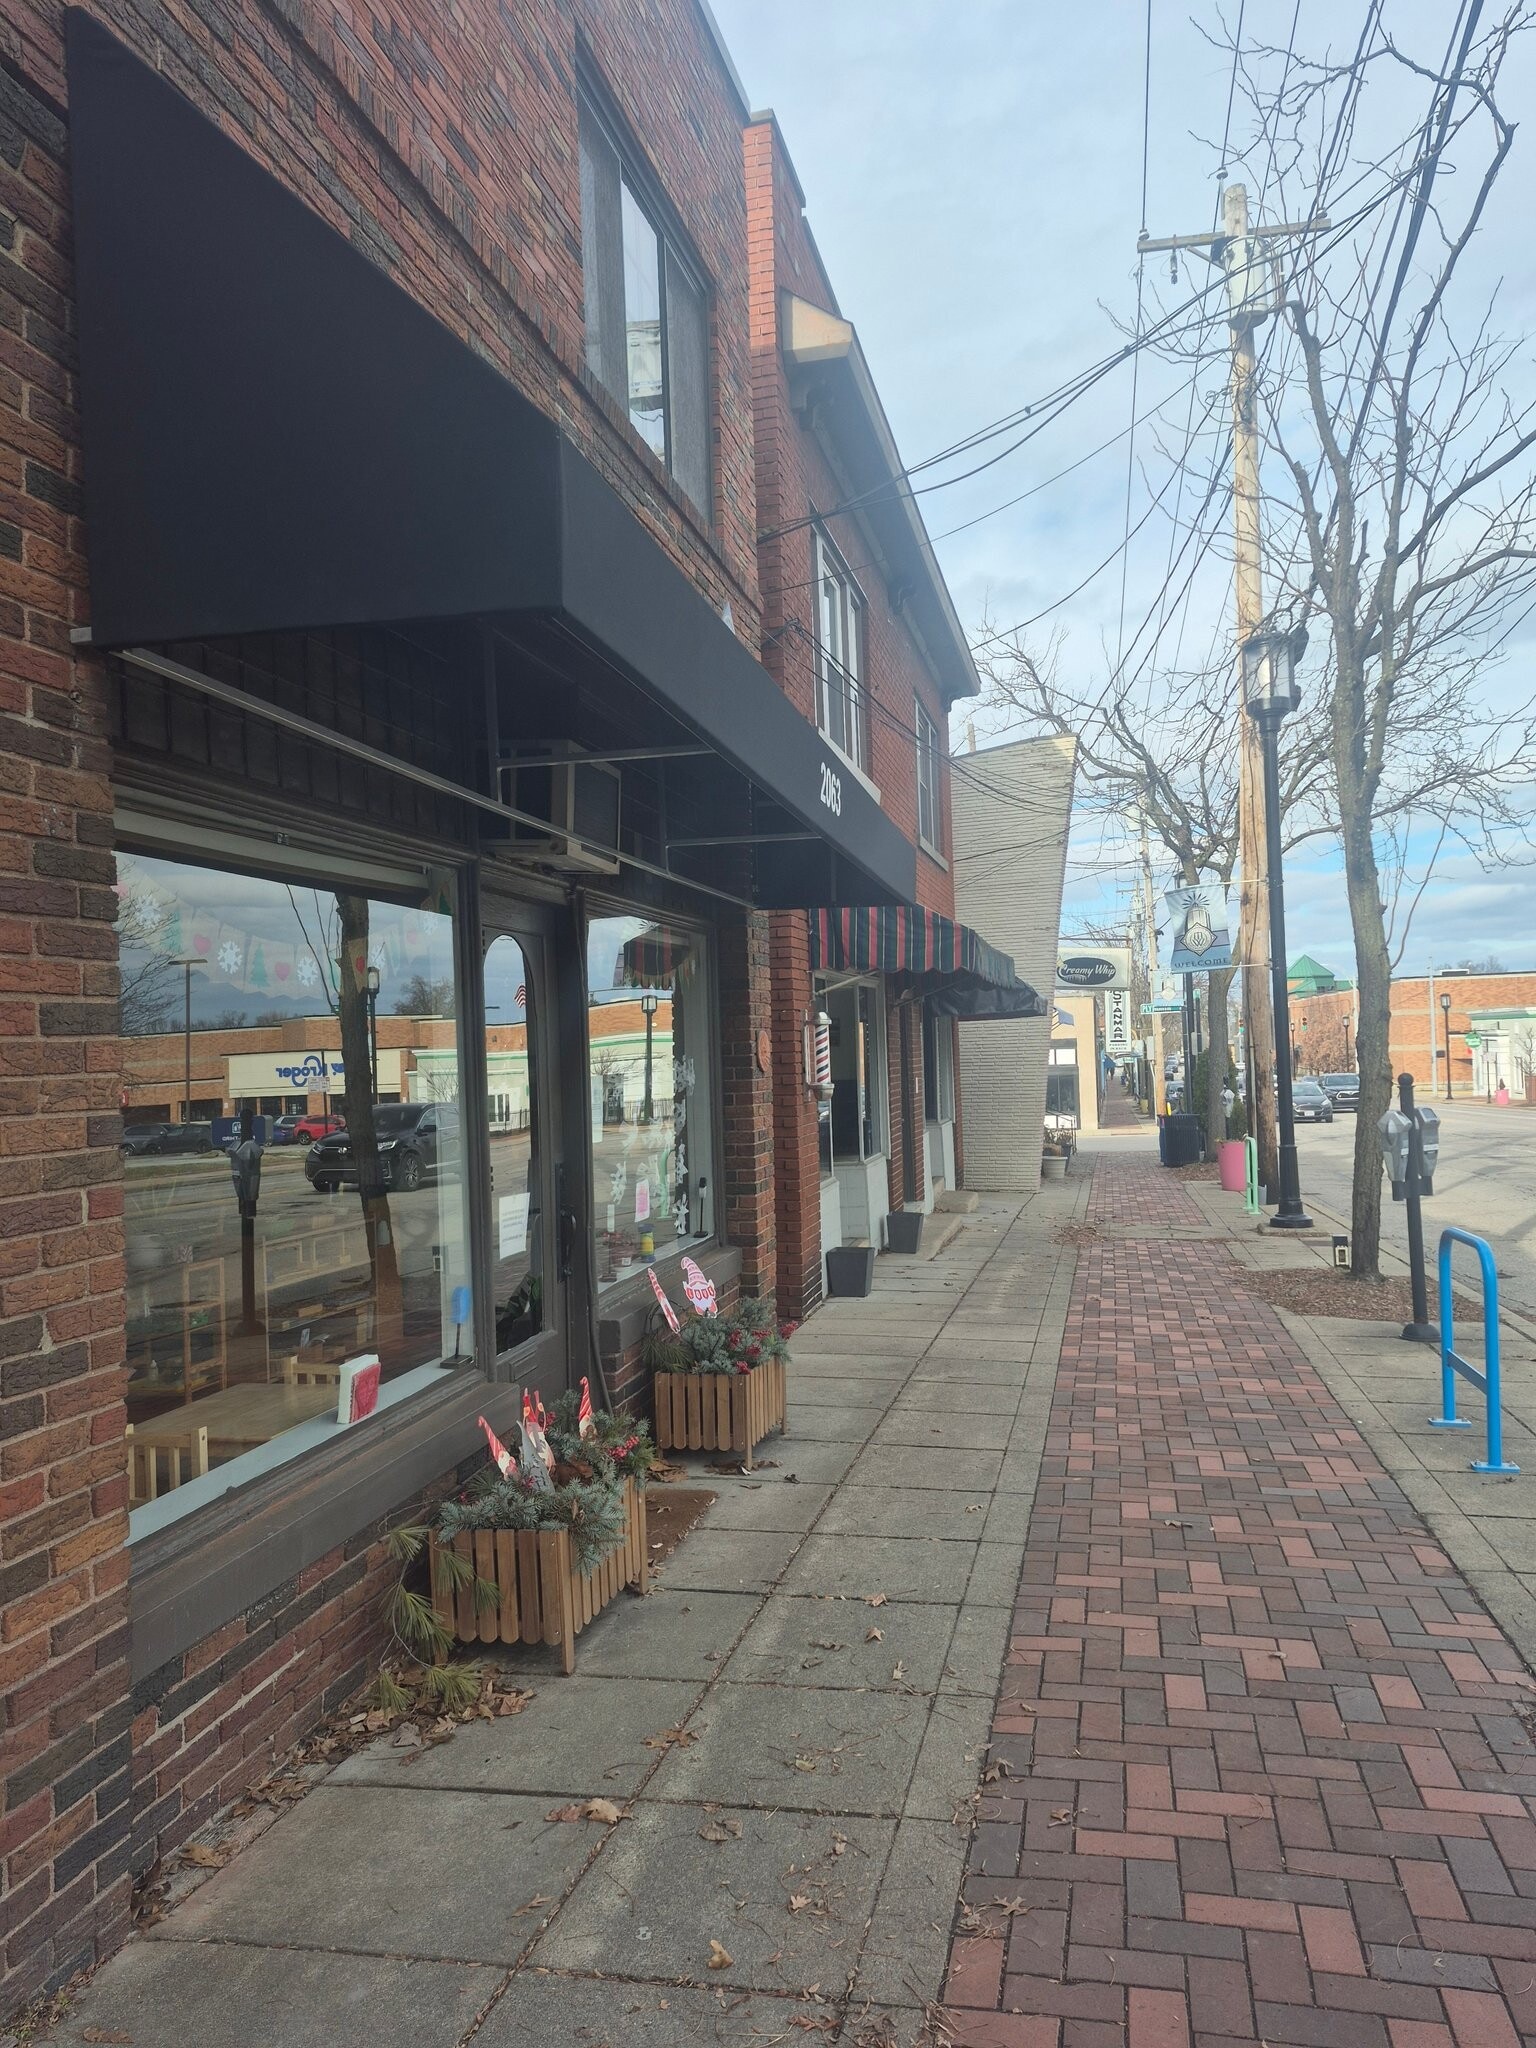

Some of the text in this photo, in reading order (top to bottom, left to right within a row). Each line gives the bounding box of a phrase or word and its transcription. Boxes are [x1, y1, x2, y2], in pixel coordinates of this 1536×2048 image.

[820, 761, 841, 817] 2063
[1058, 963, 1116, 978] Creamy Whip
[1174, 957, 1229, 969] WELCOME
